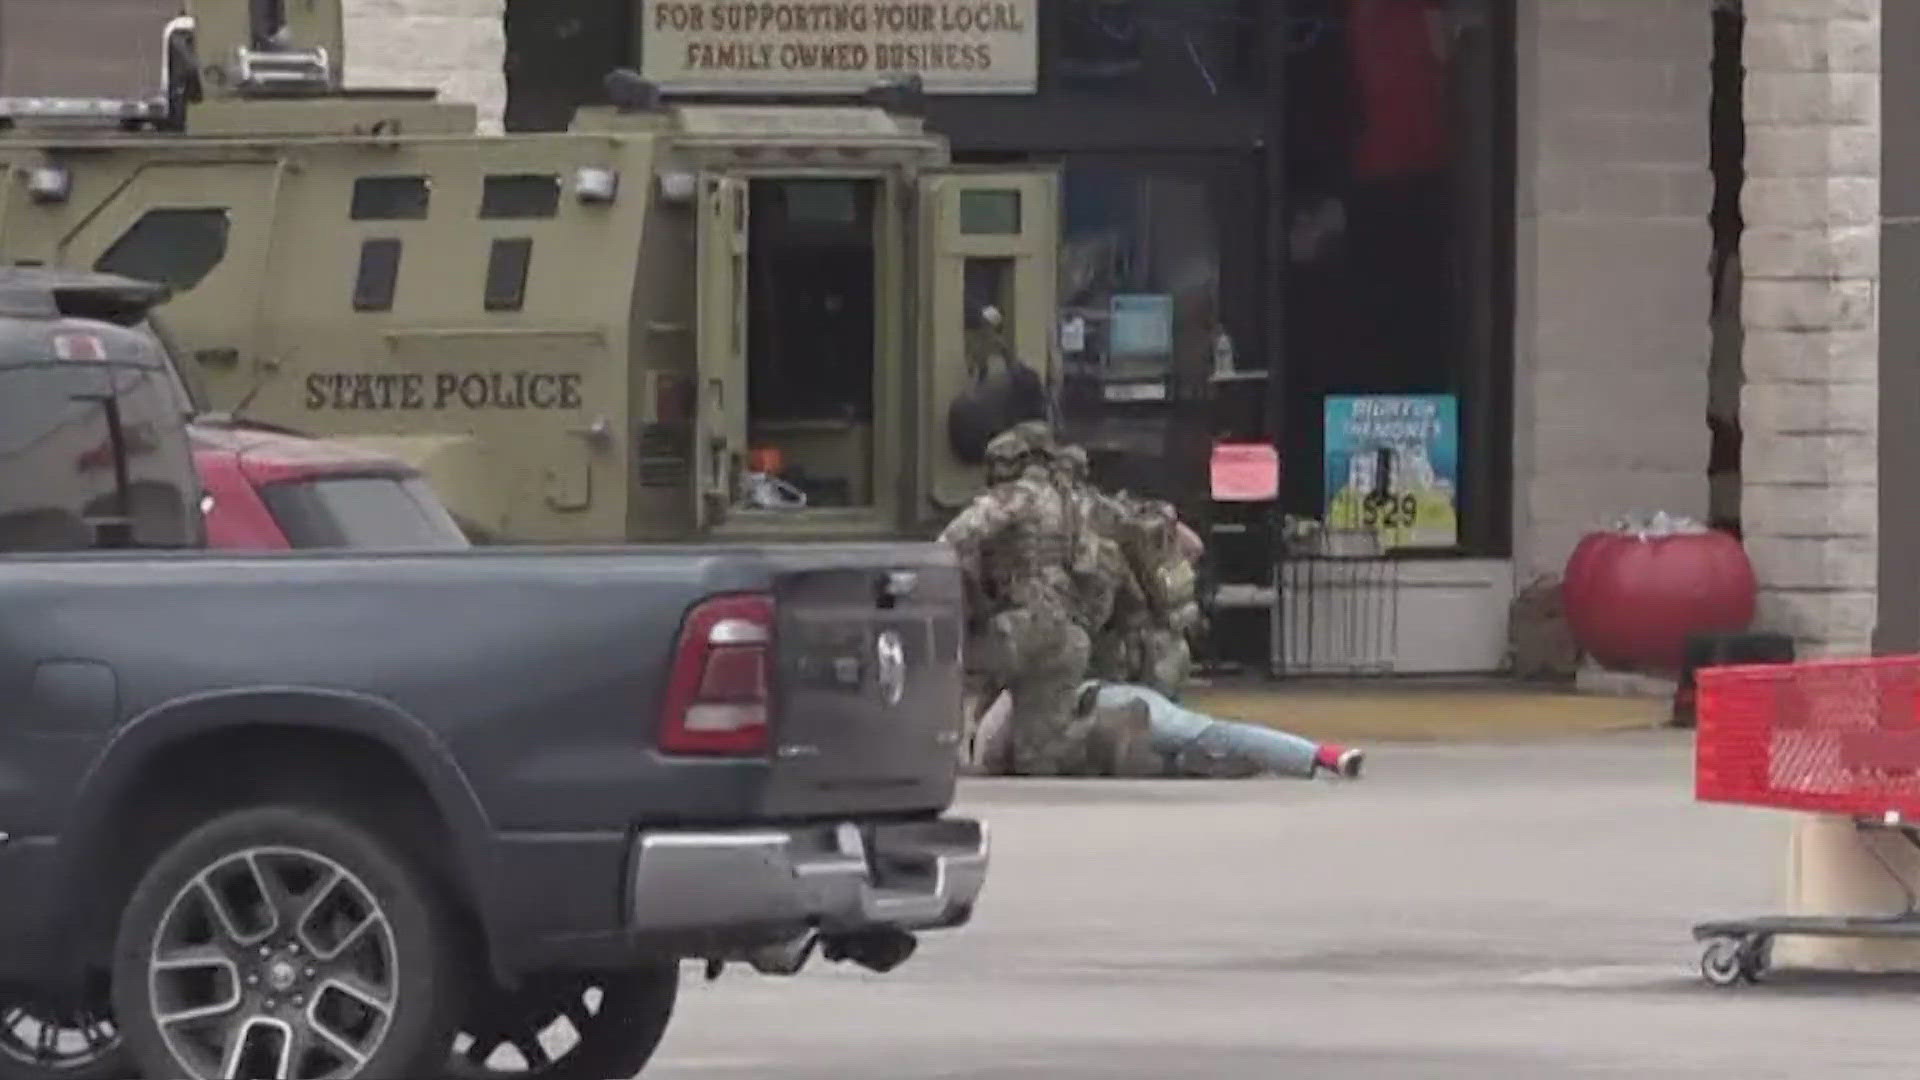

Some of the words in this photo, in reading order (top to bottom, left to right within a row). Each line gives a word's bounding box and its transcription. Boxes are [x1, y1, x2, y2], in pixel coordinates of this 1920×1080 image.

[655, 4, 704, 31] FOR
[711, 4, 867, 32] SUPPORTING
[874, 4, 935, 32] YOUR
[940, 4, 1024, 32] LOCAL
[685, 43, 774, 70] FAMILY
[780, 43, 868, 70] OWNED
[875, 43, 992, 70] BUSINESS
[304, 372, 424, 410] STATE
[432, 370, 582, 410] POLICE
